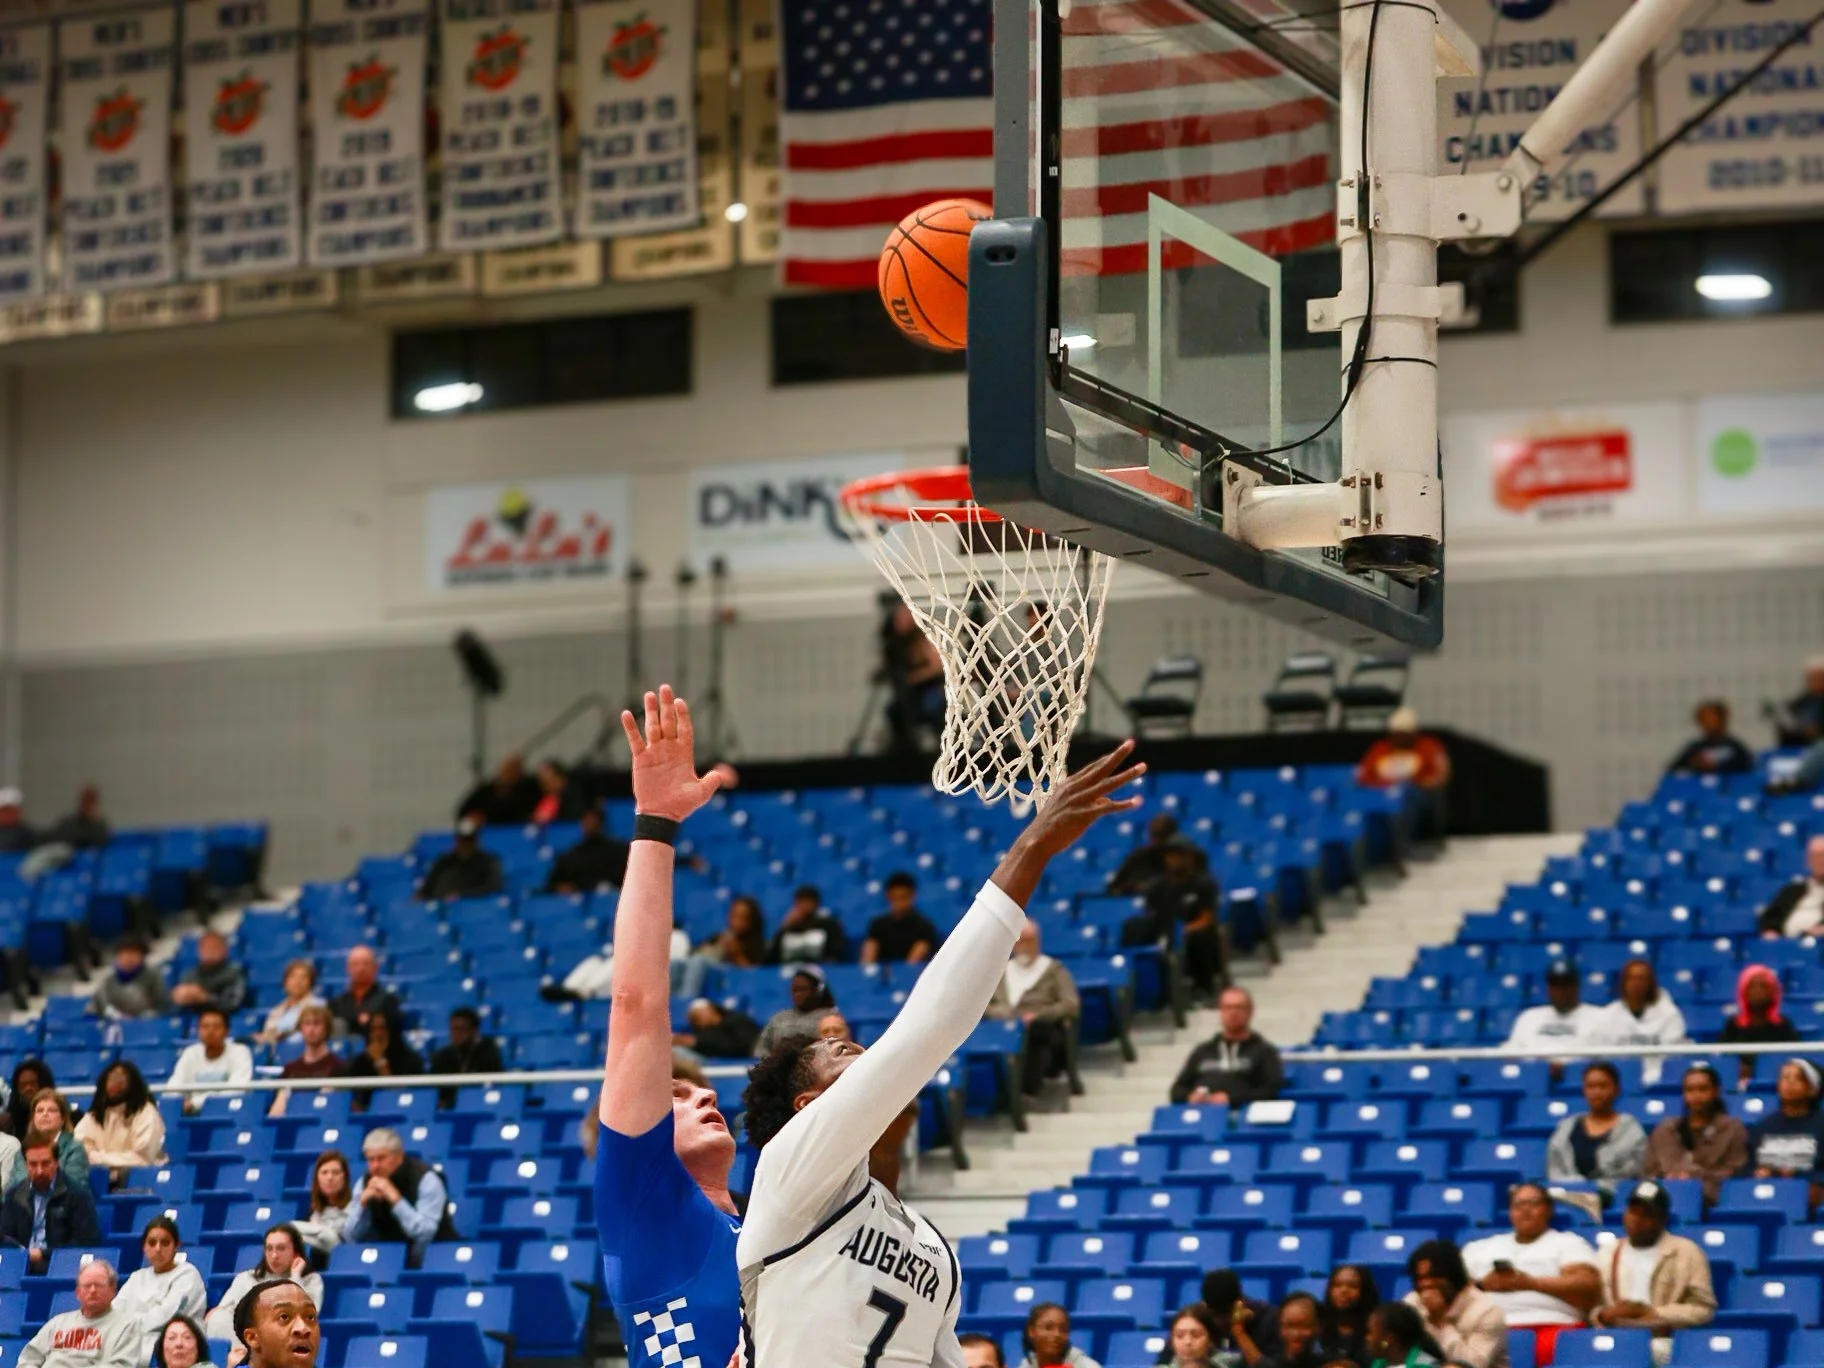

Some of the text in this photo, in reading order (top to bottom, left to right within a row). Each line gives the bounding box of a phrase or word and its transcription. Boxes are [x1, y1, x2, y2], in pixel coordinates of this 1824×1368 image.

[1481, 39, 1578, 71] VISION
[1688, 64, 1824, 99] NATIONA
[1455, 83, 1559, 118] NATIO
[1445, 124, 1619, 164] CHANS
[1680, 108, 1824, 145] CHAMPIO
[838, 1223, 940, 1304] AUGUSTA
